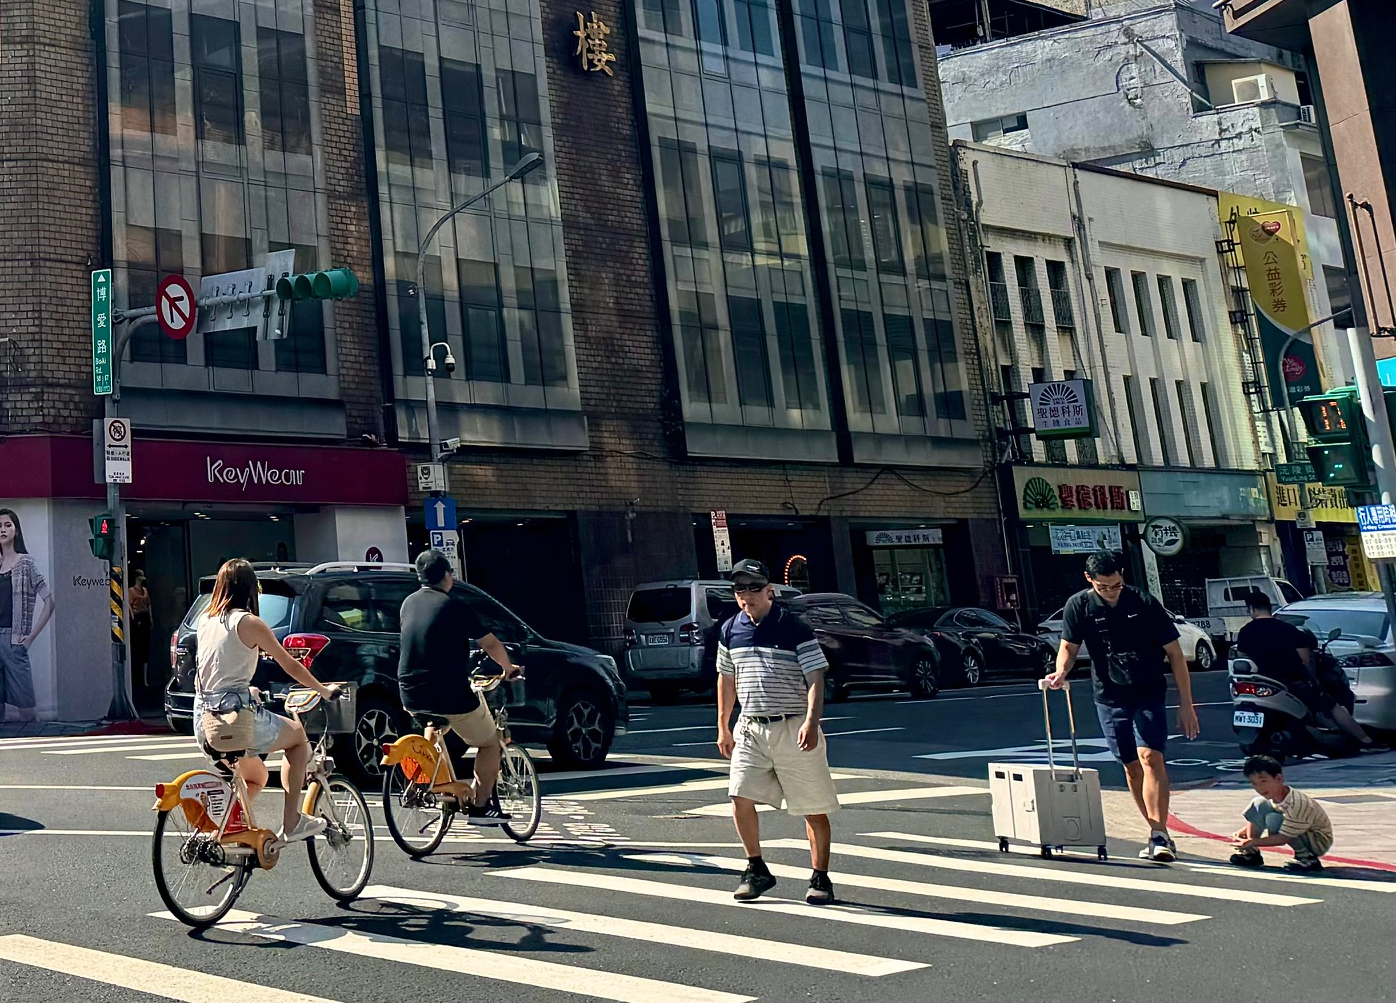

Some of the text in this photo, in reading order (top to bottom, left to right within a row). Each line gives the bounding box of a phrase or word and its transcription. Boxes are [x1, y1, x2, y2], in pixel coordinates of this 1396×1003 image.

[1263, 250, 1288, 314] 公益彩券
[96, 286, 107, 354] 博愛路
[1037, 404, 1084, 419] 聖德科斯
[206, 455, 305, 491] KeyWear
[1058, 484, 1126, 510] 聖德科斯
[433, 534, 442, 544] P
[1150, 524, 1180, 538] 有機
